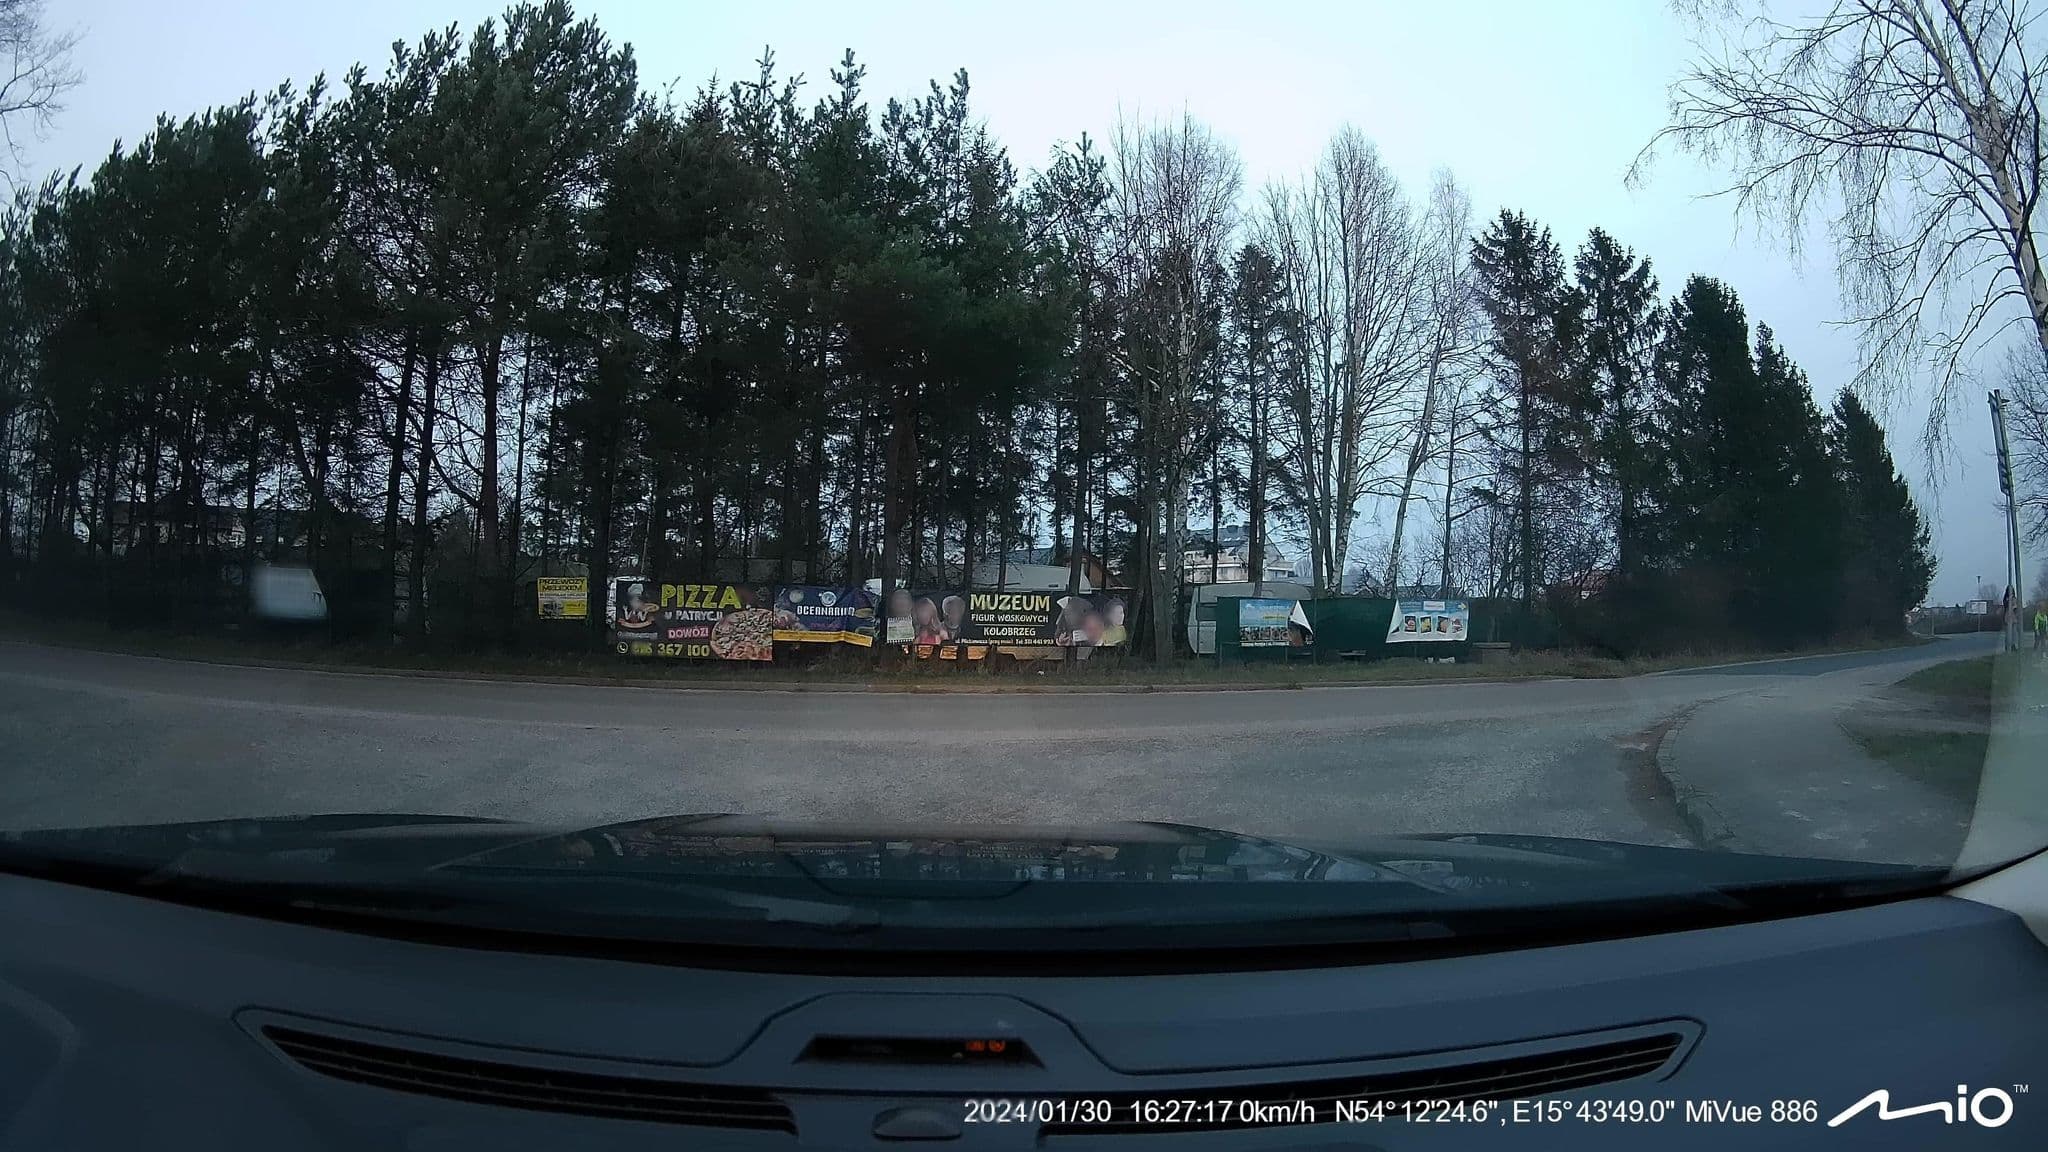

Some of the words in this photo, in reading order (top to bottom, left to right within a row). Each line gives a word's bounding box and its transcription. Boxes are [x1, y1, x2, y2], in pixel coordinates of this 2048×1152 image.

[661, 583, 742, 609] PIZZA
[970, 593, 1050, 612] MUZEUM
[675, 610, 723, 621] PATRYCJI
[971, 613, 995, 622] FIGUR
[997, 614, 1049, 623] WOSKOWYCH
[657, 643, 683, 656] 367
[687, 644, 710, 657] 100
